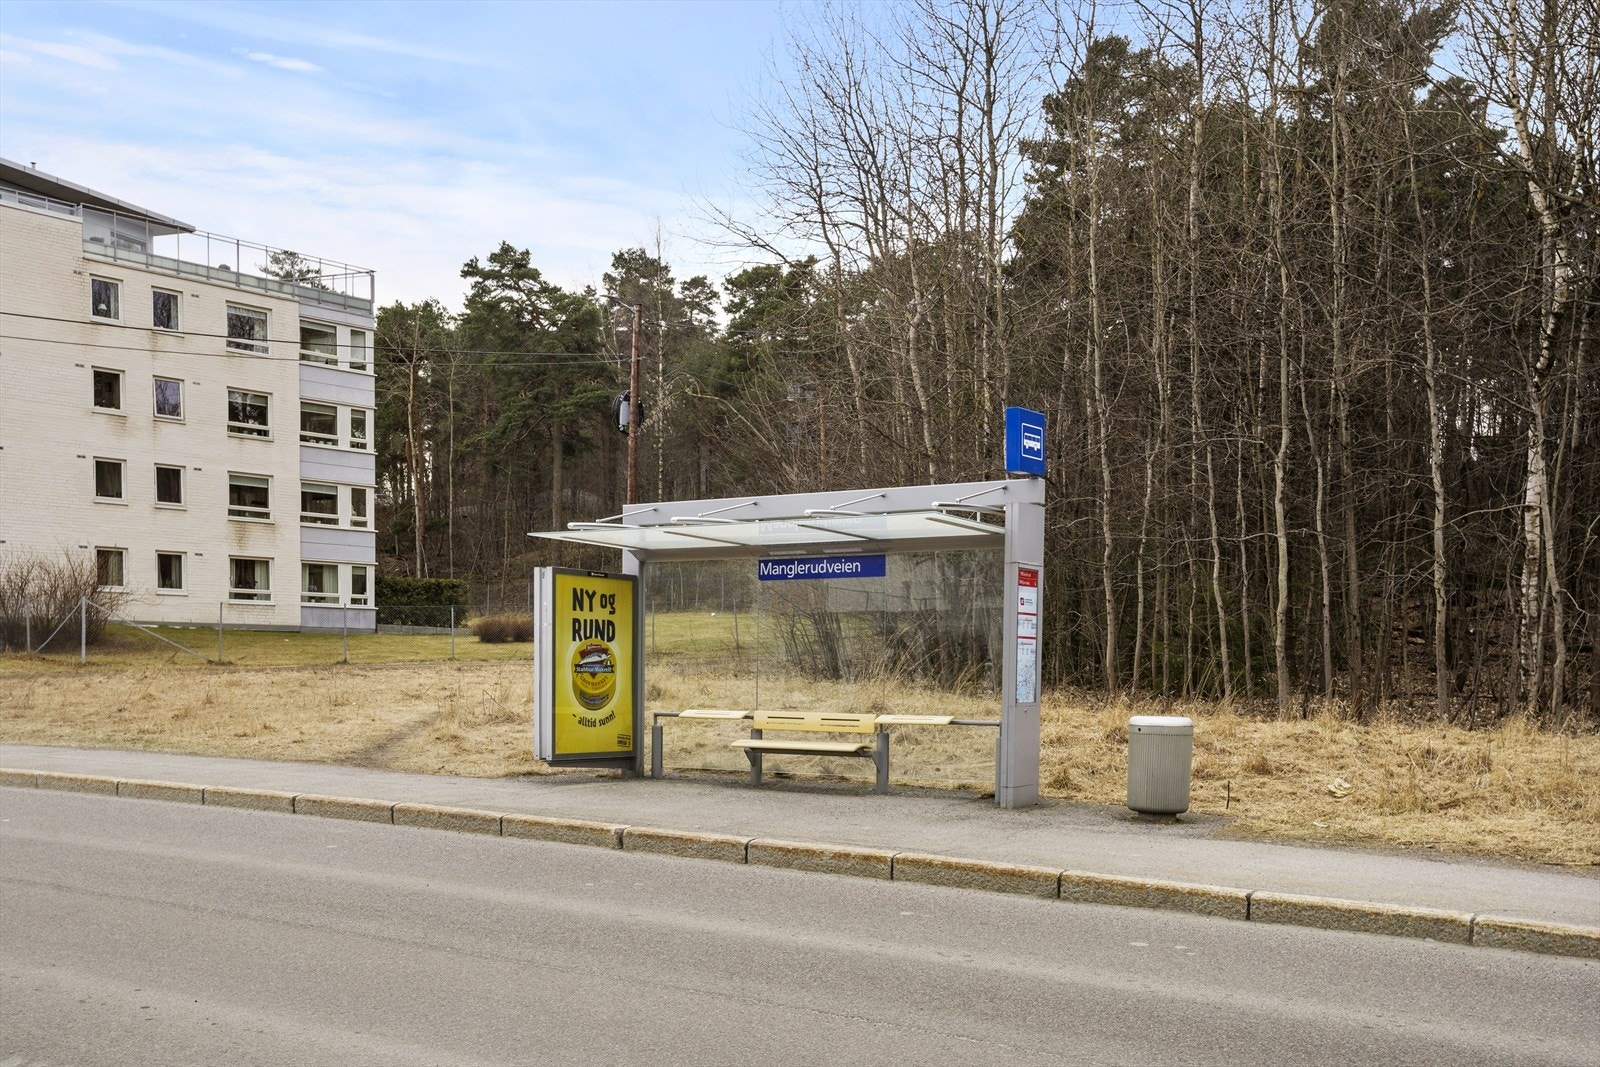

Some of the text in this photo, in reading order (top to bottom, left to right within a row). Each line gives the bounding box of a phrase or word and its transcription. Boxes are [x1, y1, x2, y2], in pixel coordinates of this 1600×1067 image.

[760, 559, 861, 578] Manglerudveien
[572, 587, 616, 615] NY og
[572, 617, 616, 643] RUND
[578, 716, 597, 728] alltid
[598, 710, 616, 727] sunn!
